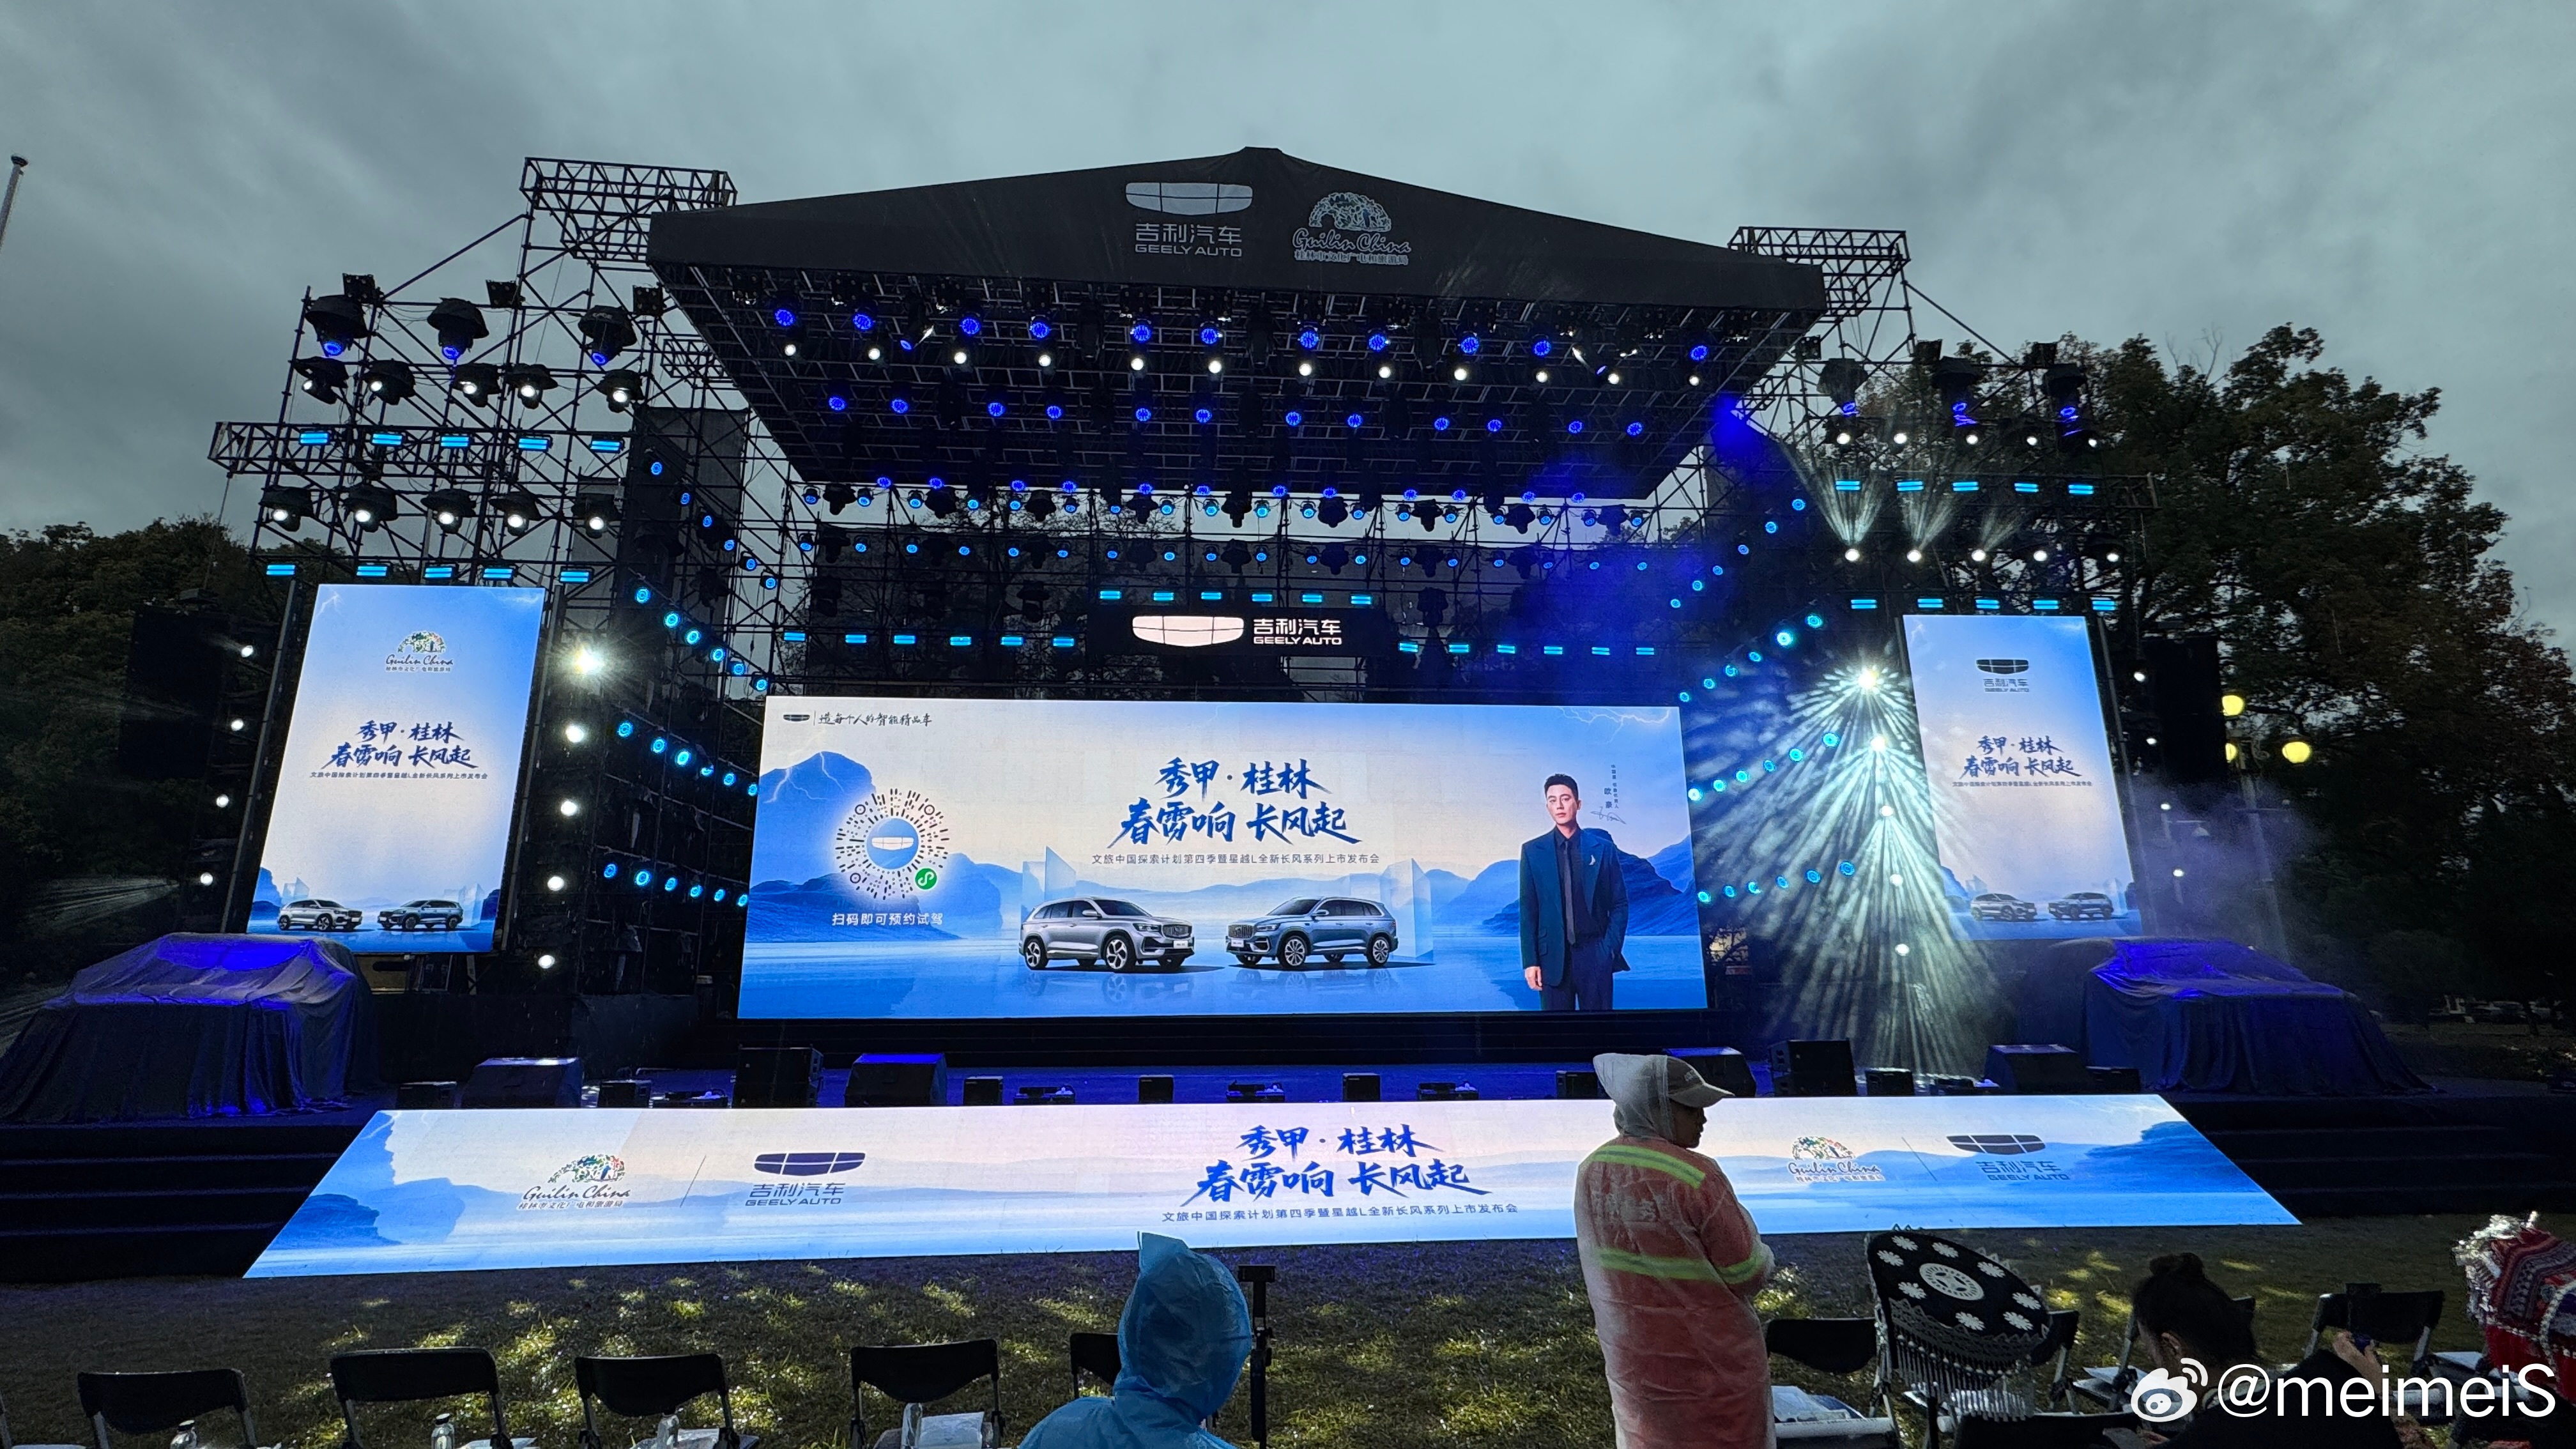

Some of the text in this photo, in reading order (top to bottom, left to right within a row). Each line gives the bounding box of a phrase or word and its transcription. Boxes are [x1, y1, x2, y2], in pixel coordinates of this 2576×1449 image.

[1135, 223, 1242, 245] 吉利汽车
[1292, 227, 1411, 253] Guilin China
[1135, 244, 1243, 257] GEELY AUTO
[1254, 618, 1342, 635] 吉利汽车
[1253, 636, 1301, 645] GEELY
[386, 654, 453, 665] Guilin China
[1983, 678, 2029, 687] 吉利汽车
[408, 745, 479, 769] 长风起
[2024, 756, 2082, 778] 长风起
[1246, 802, 1362, 845] 长风起
[1092, 854, 1380, 864] 文旅中国探索计划第四季暨星越L全新长风系列上市发布会
[832, 912, 944, 926] 扫码即可预约试驾
[1788, 1162, 1880, 1175] Guilin China
[1975, 1160, 2061, 1173] 吉利汽车
[1348, 1158, 1492, 1198] 长风起
[523, 1184, 631, 1201] Guilin China
[749, 1183, 846, 1197] 吉利汽车
[745, 1198, 797, 1206] GEELY
[1162, 1203, 1518, 1223] 文旅中国探索计划第四季暨星越L全新长风系列上市发布会
